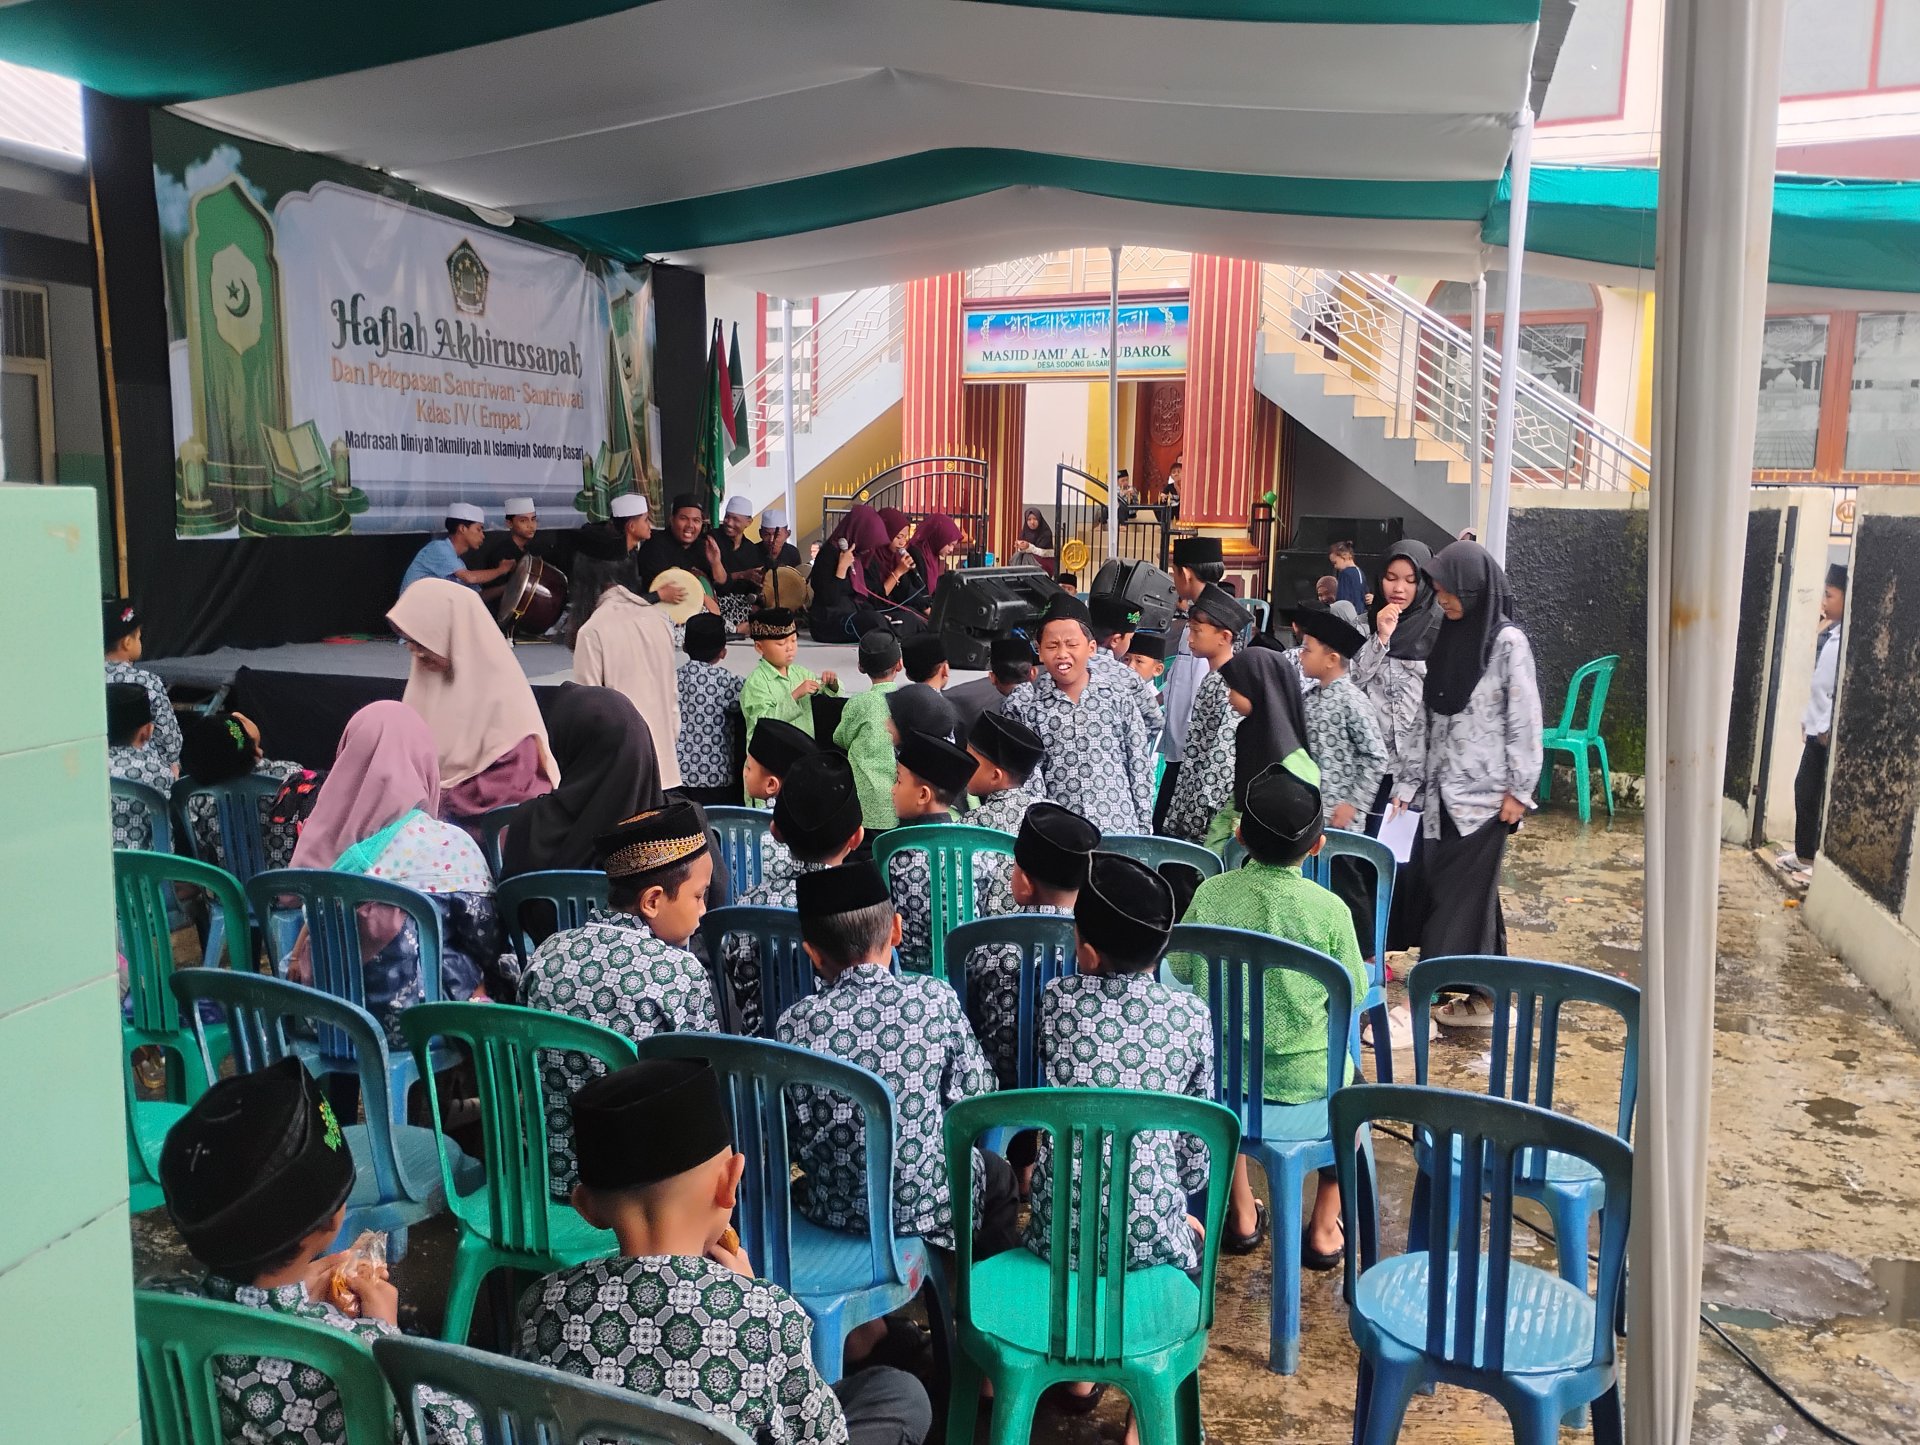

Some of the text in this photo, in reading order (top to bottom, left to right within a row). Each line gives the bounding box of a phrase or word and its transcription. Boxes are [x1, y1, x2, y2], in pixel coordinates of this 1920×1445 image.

[331, 293, 583, 379] Haflah Akhirussanah
[982, 350, 1029, 362] MASJID
[1032, 349, 1068, 361] JAMI'
[1071, 348, 1090, 359] AL
[1037, 361, 1055, 369] DESA
[1056, 360, 1086, 369] SODONG
[331, 356, 366, 385] Dan
[368, 361, 442, 395] Pelepasan
[444, 371, 516, 401] Santriwan
[522, 382, 585, 409] Santriwati
[416, 398, 452, 425] Kelas
[454, 403, 469, 426] IV
[345, 430, 584, 461] Madrasah Diniyah Takmiliyah Al Islamiyah Sodong Basari
